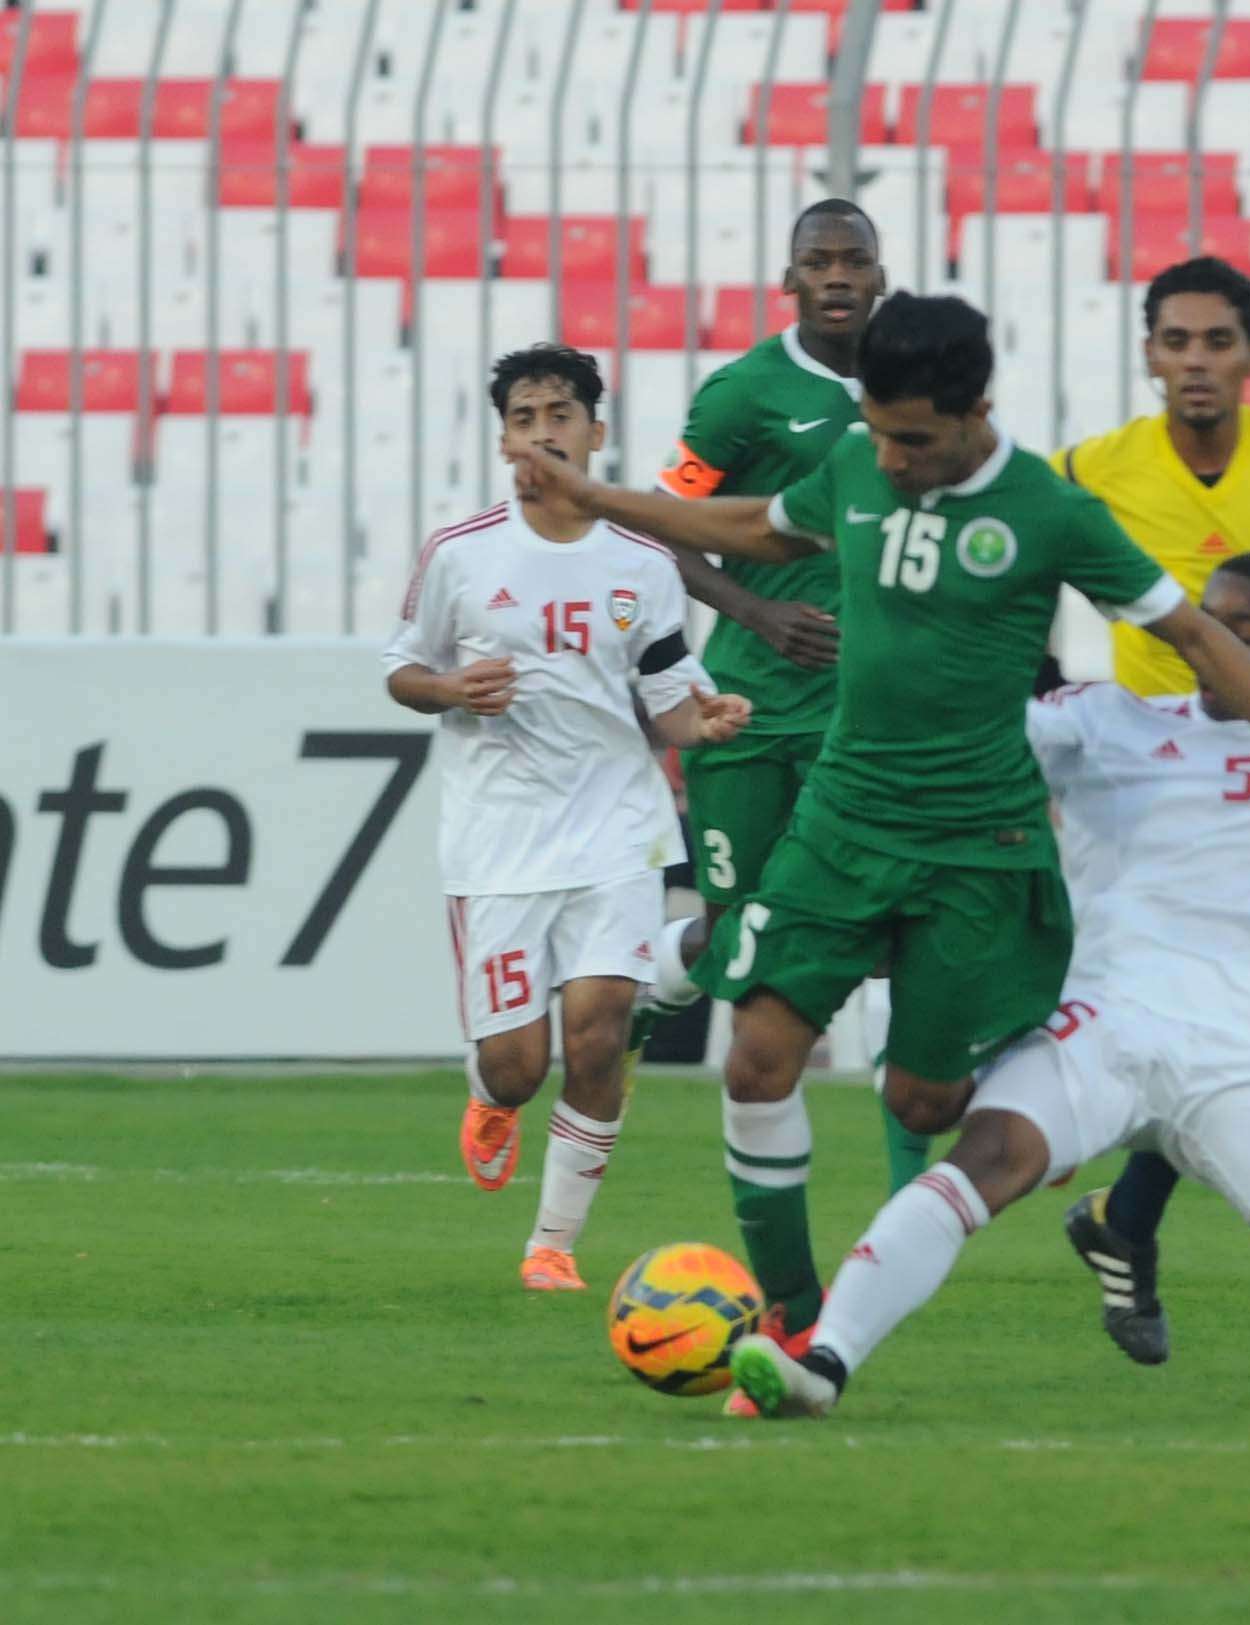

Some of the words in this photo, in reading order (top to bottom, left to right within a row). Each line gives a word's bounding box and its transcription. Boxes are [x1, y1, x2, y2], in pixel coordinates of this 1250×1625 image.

[878, 507, 947, 593] 15
[541, 600, 592, 656] 15
[0, 730, 434, 970] te7
[703, 828, 737, 888] 3
[484, 949, 530, 1013] 15
